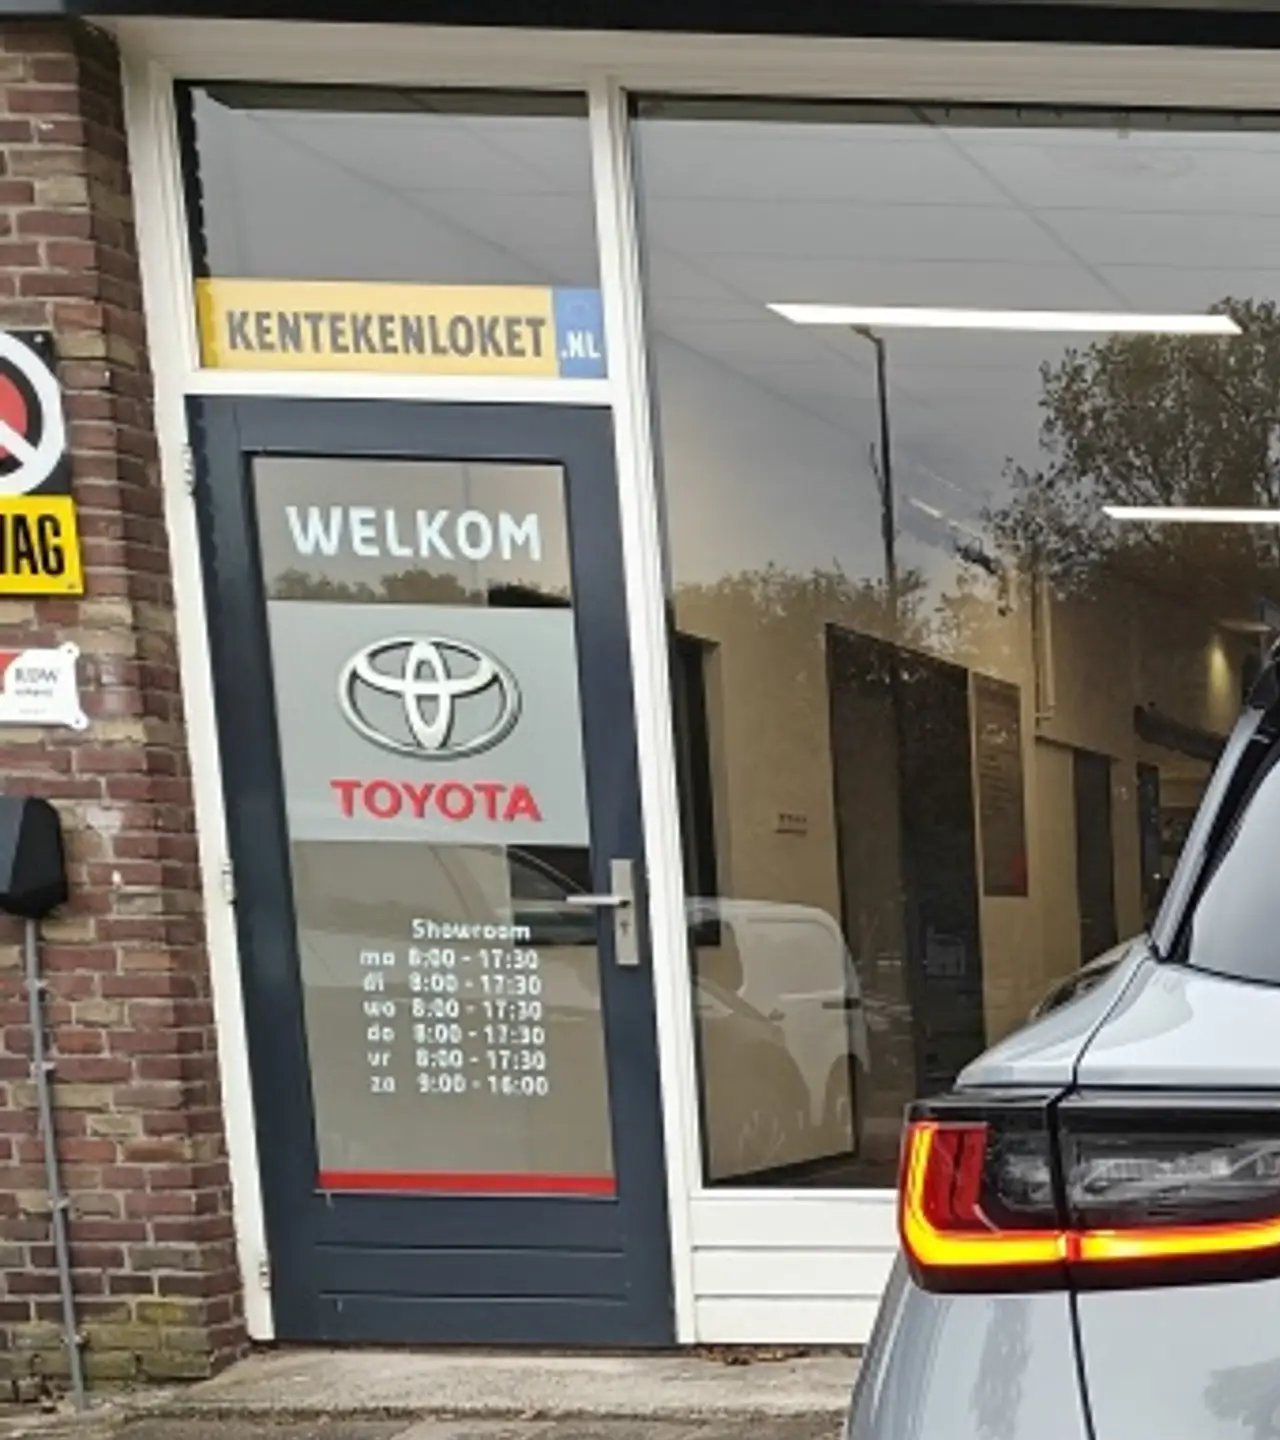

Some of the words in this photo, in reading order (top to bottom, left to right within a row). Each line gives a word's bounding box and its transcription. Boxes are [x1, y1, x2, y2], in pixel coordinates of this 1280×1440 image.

[224, 309, 547, 359] KENTEKENLOKET
[285, 505, 542, 561] WELKOM
[329, 779, 544, 823] TOYOTA
[411, 918, 532, 940] Showroom
[479, 948, 539, 970] 17:30
[363, 971, 385, 992] di
[480, 974, 542, 995] 17:30
[483, 1000, 543, 1021] 17:30
[367, 1022, 395, 1042] do
[484, 1024, 545, 1045] 17:30
[486, 1050, 546, 1071] 17:30
[487, 1076, 549, 1096] 16:00
